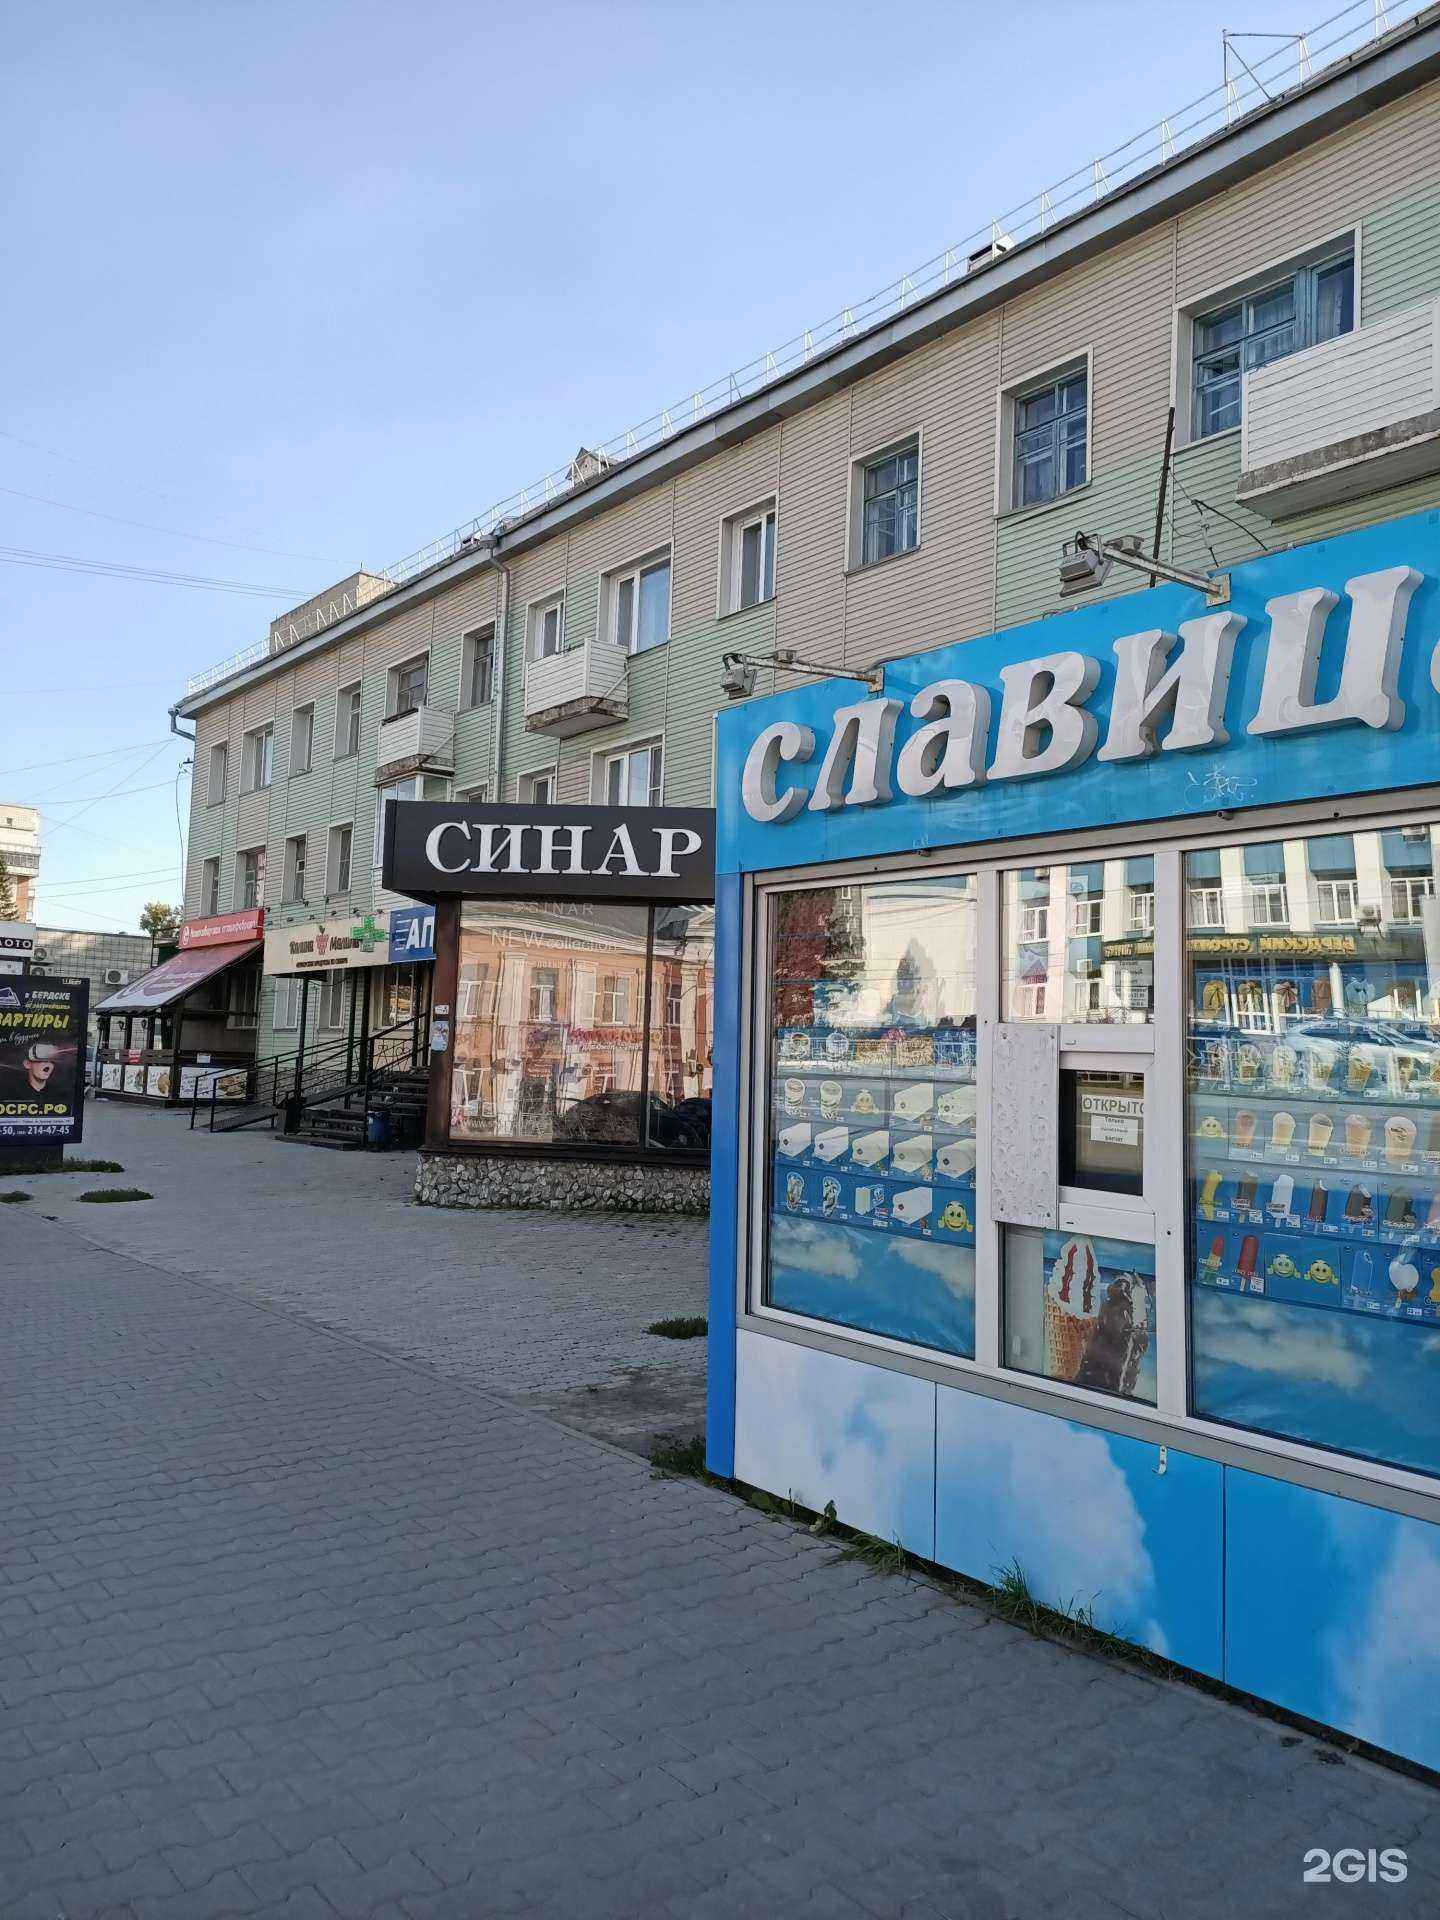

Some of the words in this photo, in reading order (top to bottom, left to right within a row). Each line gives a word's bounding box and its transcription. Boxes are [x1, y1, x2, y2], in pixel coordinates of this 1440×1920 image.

[741, 565, 1440, 823] славиц
[425, 820, 702, 878] СИНАР
[0, 938, 33, 949] ОТО
[490, 928, 544, 949] NEW
[31, 991, 71, 1001] БЕРДСКЕ
[28, 1125, 70, 1135] 214-47-45
